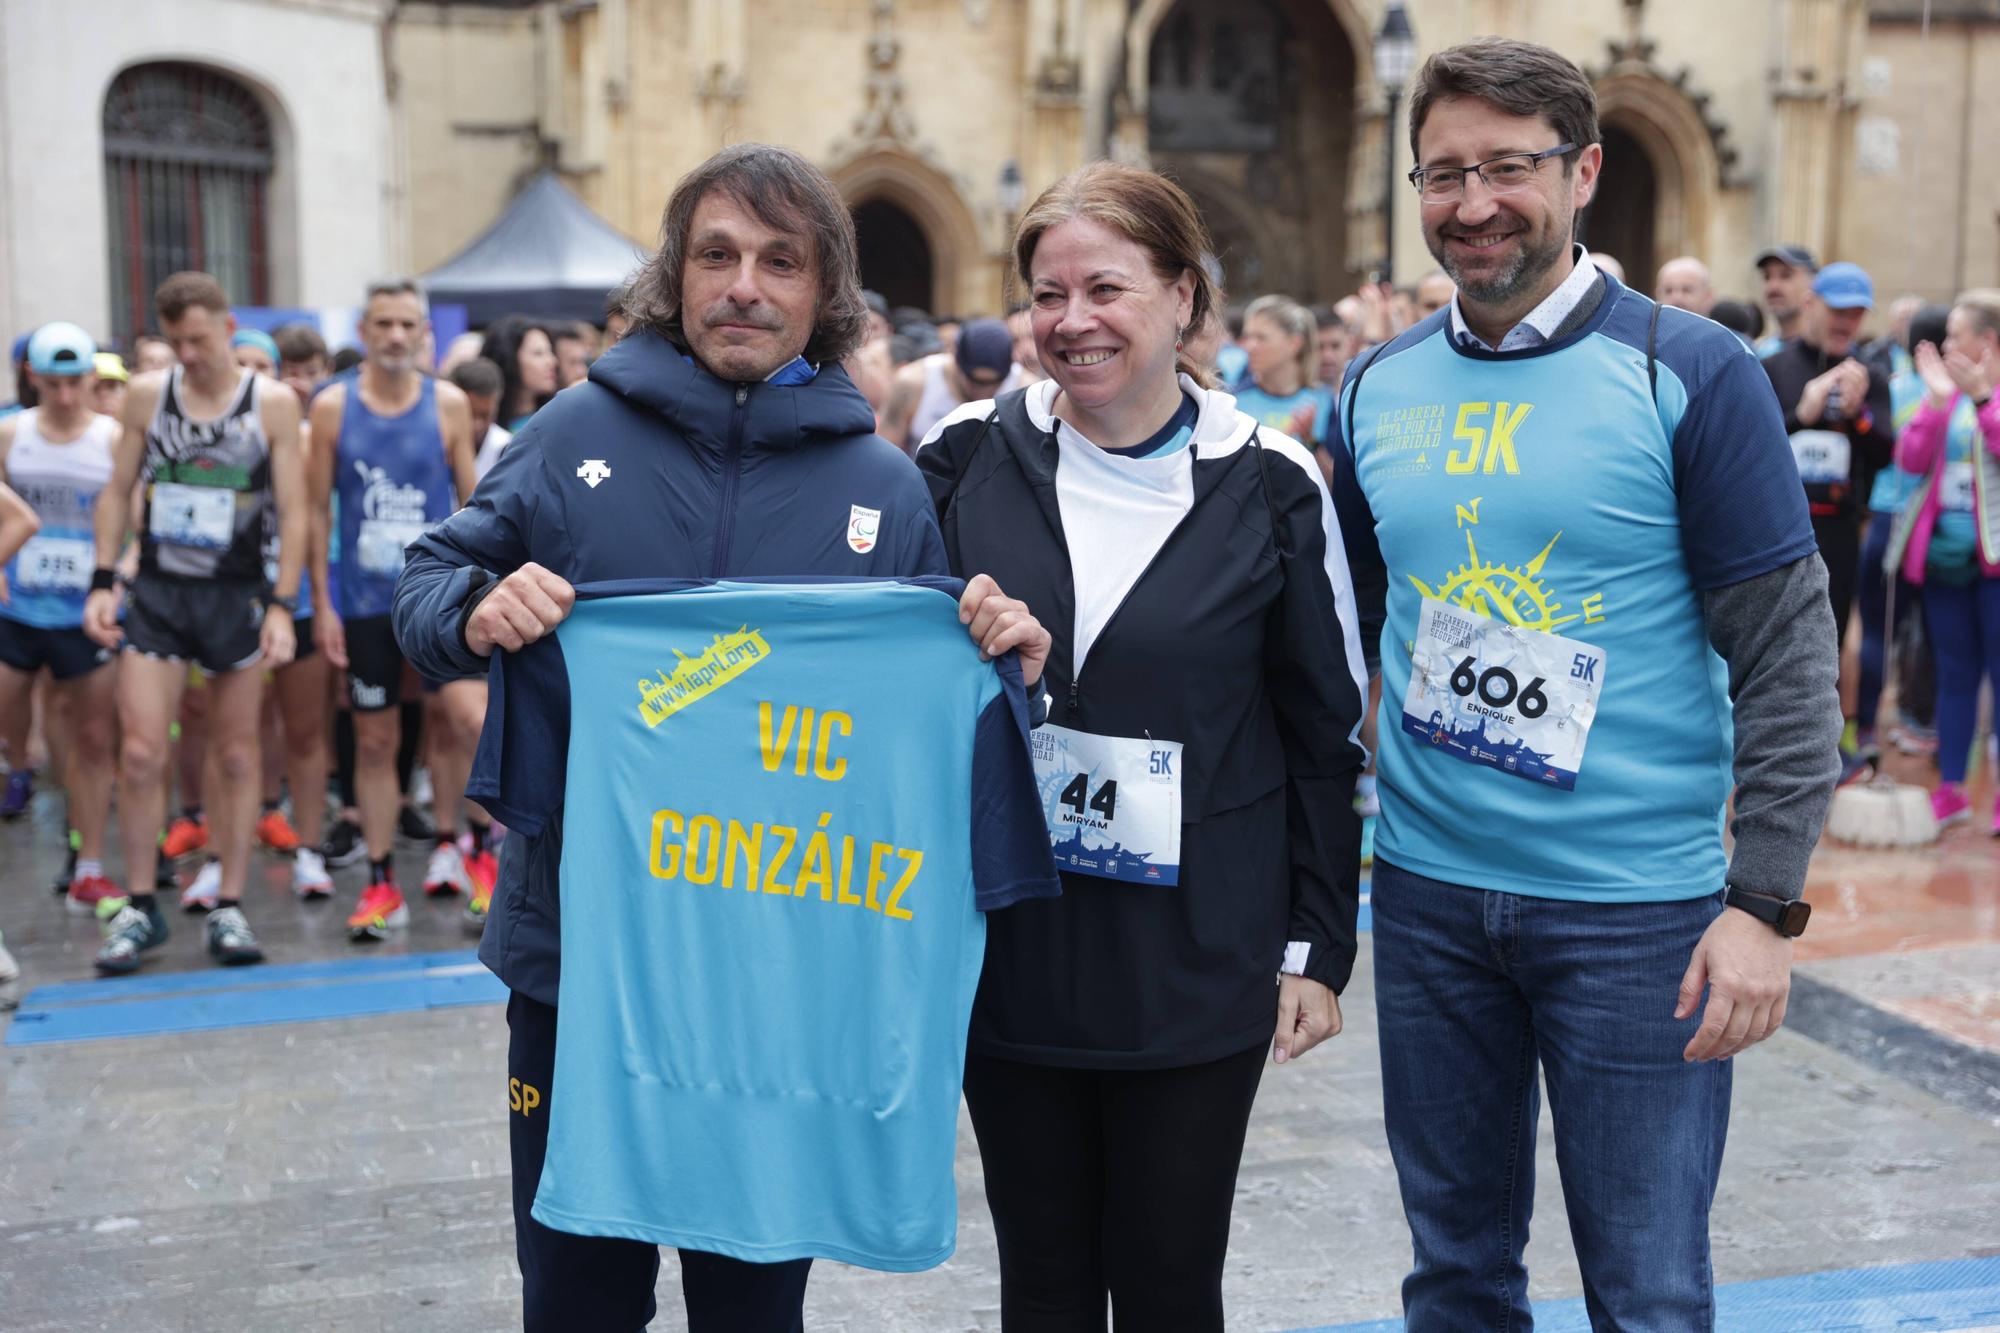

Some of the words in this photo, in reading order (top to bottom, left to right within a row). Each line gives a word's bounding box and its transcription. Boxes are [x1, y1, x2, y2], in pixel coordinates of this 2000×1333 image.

[1394, 404, 1446, 422] CARRERA
[1404, 419, 1426, 434] POR
[1429, 418, 1443, 432] LA
[1445, 402, 1535, 475] 5K
[1456, 497, 1482, 528] N
[1432, 619, 1448, 632] RUTA
[1450, 626, 1462, 638] POR
[1462, 630, 1471, 640] LA
[1433, 610, 1442, 620] IV
[1444, 614, 1472, 632] CARRERA
[1430, 628, 1471, 649] SEGURIDAD
[647, 640, 760, 714] www.iaprl.org
[1570, 653, 1598, 682] 5K
[1450, 656, 1548, 718] 606
[1466, 702, 1516, 725] ENRIQUE
[759, 700, 853, 782] VIC
[1030, 731, 1056, 743] RRERA
[1046, 742, 1054, 752] LA
[1150, 750, 1173, 776] 5K
[1060, 772, 1117, 820] 44
[1062, 814, 1108, 830] MIRYAM
[649, 809, 924, 922] GONZÁLEZ
